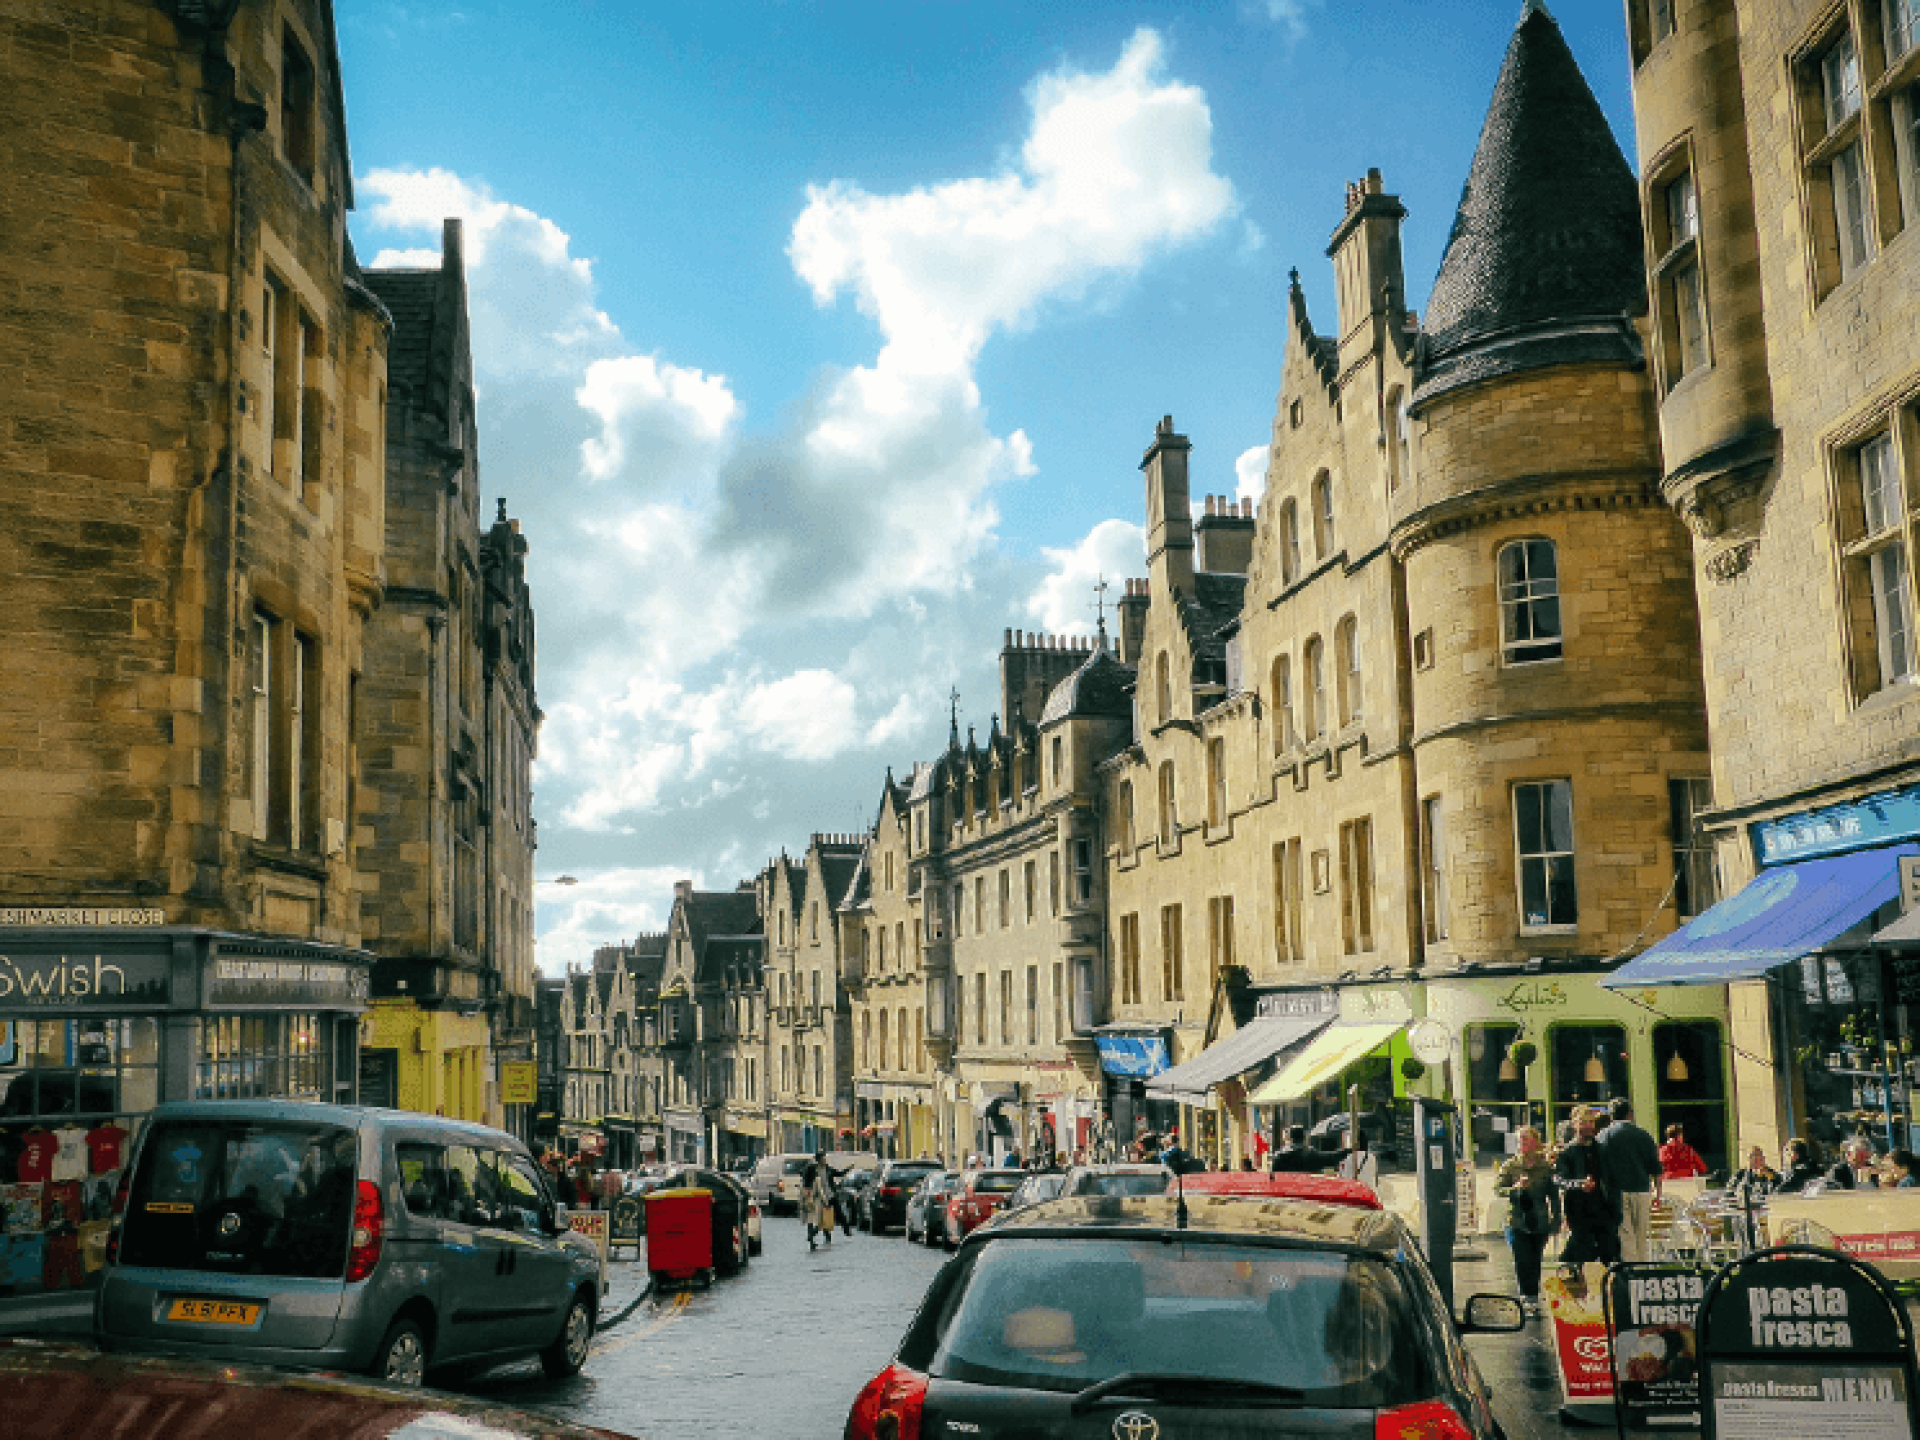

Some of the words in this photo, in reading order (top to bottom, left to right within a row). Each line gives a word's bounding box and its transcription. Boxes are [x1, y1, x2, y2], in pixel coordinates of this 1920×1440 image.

[0, 954, 125, 997] Swish
[1628, 1275, 1704, 1300] pasta
[1748, 1283, 1849, 1317] pasta
[1751, 1320, 1853, 1347] fresca
